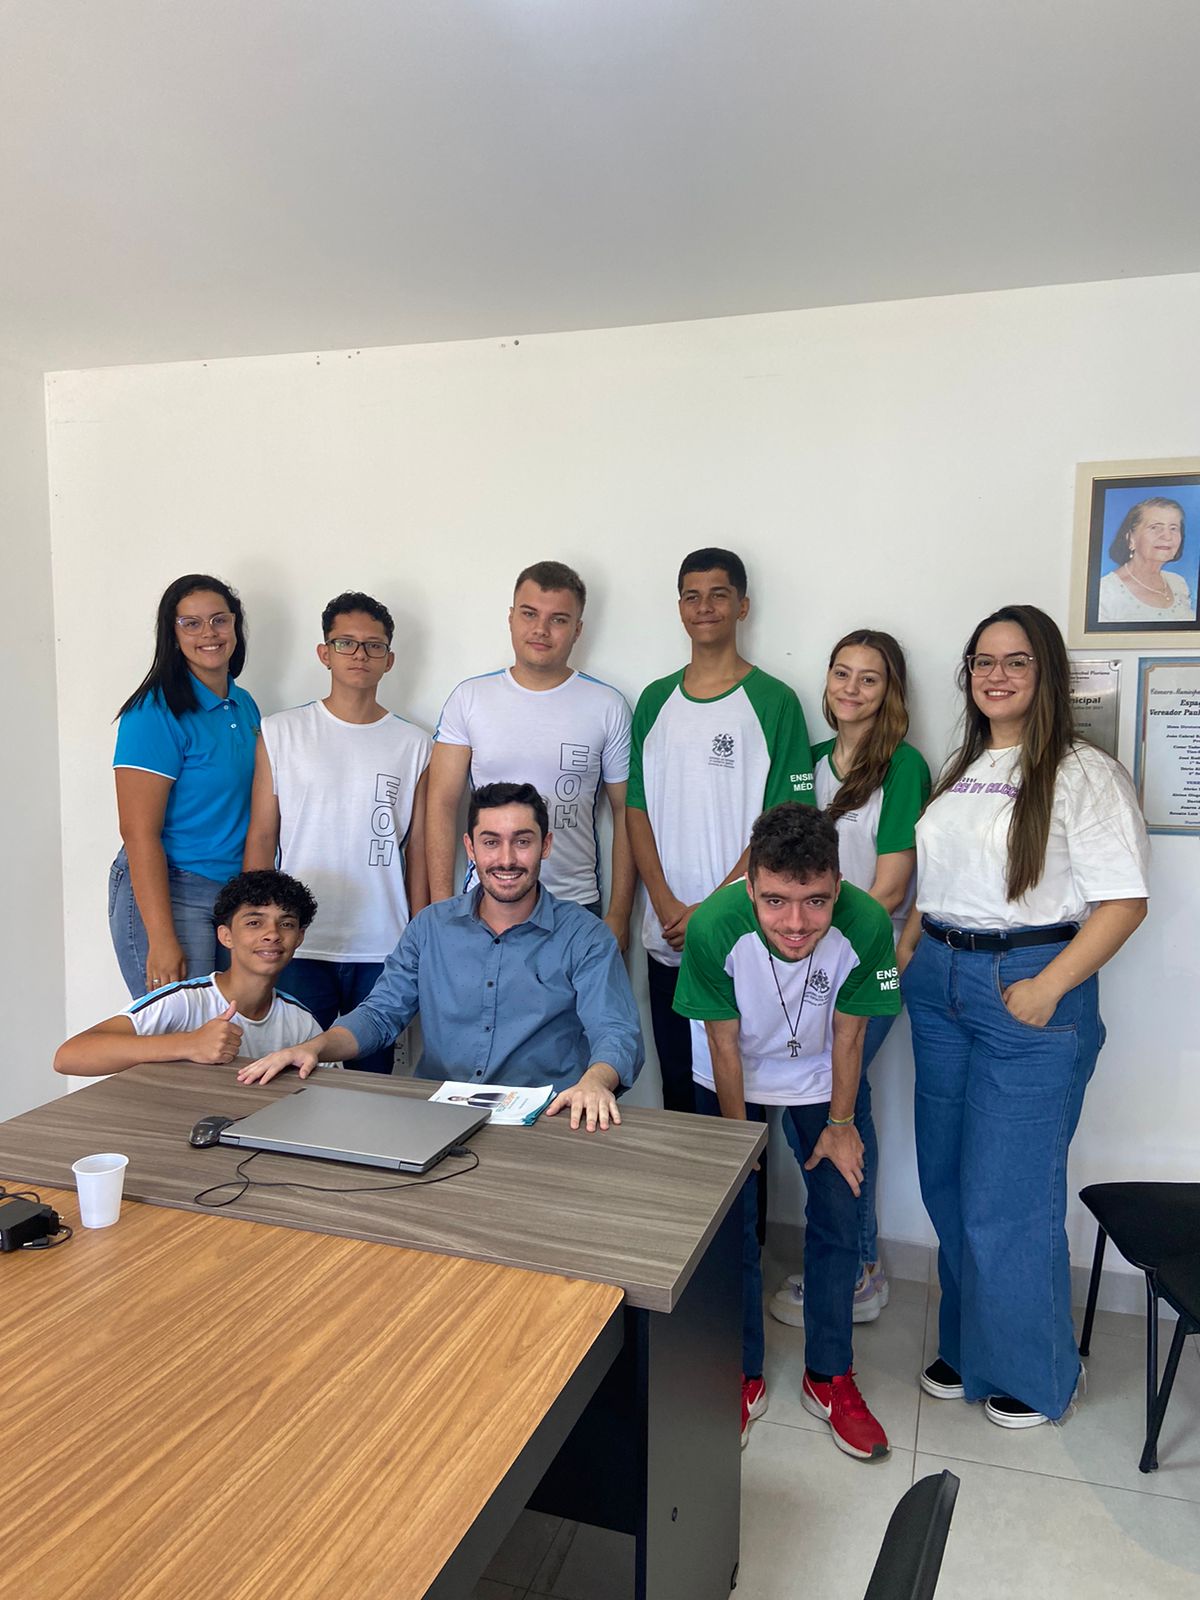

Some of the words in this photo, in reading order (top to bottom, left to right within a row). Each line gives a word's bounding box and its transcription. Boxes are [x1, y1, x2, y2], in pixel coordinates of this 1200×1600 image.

[368, 773, 401, 867] EOH
[554, 742, 590, 830] EOH
[876, 967, 898, 980] ENS
